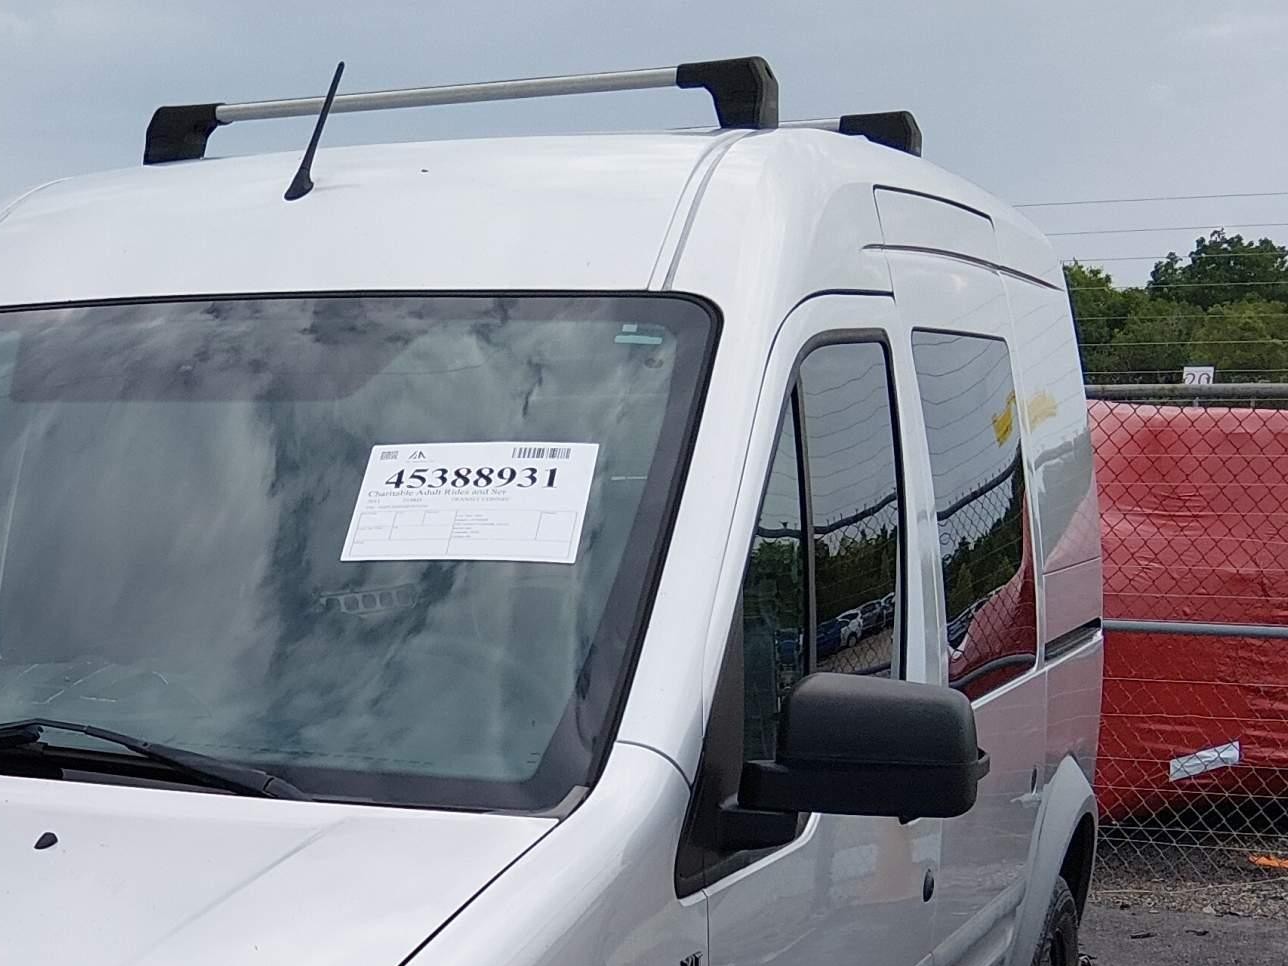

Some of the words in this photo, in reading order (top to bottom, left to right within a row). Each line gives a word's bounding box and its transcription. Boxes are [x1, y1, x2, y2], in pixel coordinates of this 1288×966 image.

[385, 467, 559, 489] 45388931
[367, 489, 413, 498] Charitable
[415, 488, 442, 496] Adult
[444, 487, 467, 496] Rides
[470, 488, 489, 496] and
